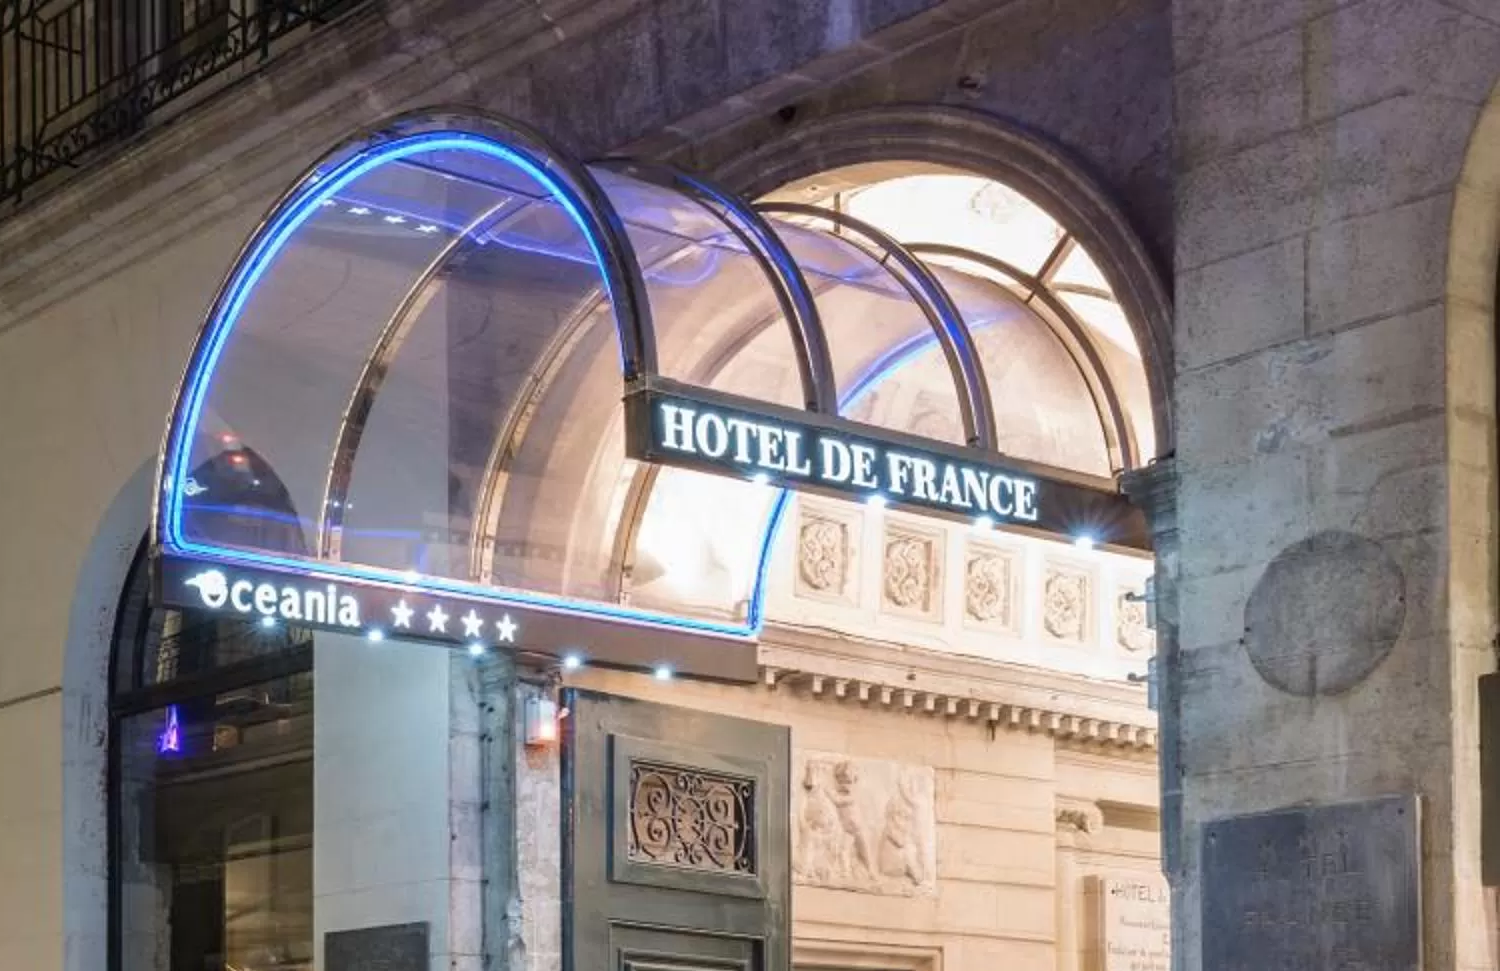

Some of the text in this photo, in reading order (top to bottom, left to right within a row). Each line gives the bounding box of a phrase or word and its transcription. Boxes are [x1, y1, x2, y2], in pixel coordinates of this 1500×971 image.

[661, 404, 1039, 521] HOTEL DE FRANCE
[186, 568, 361, 628] Oceania
